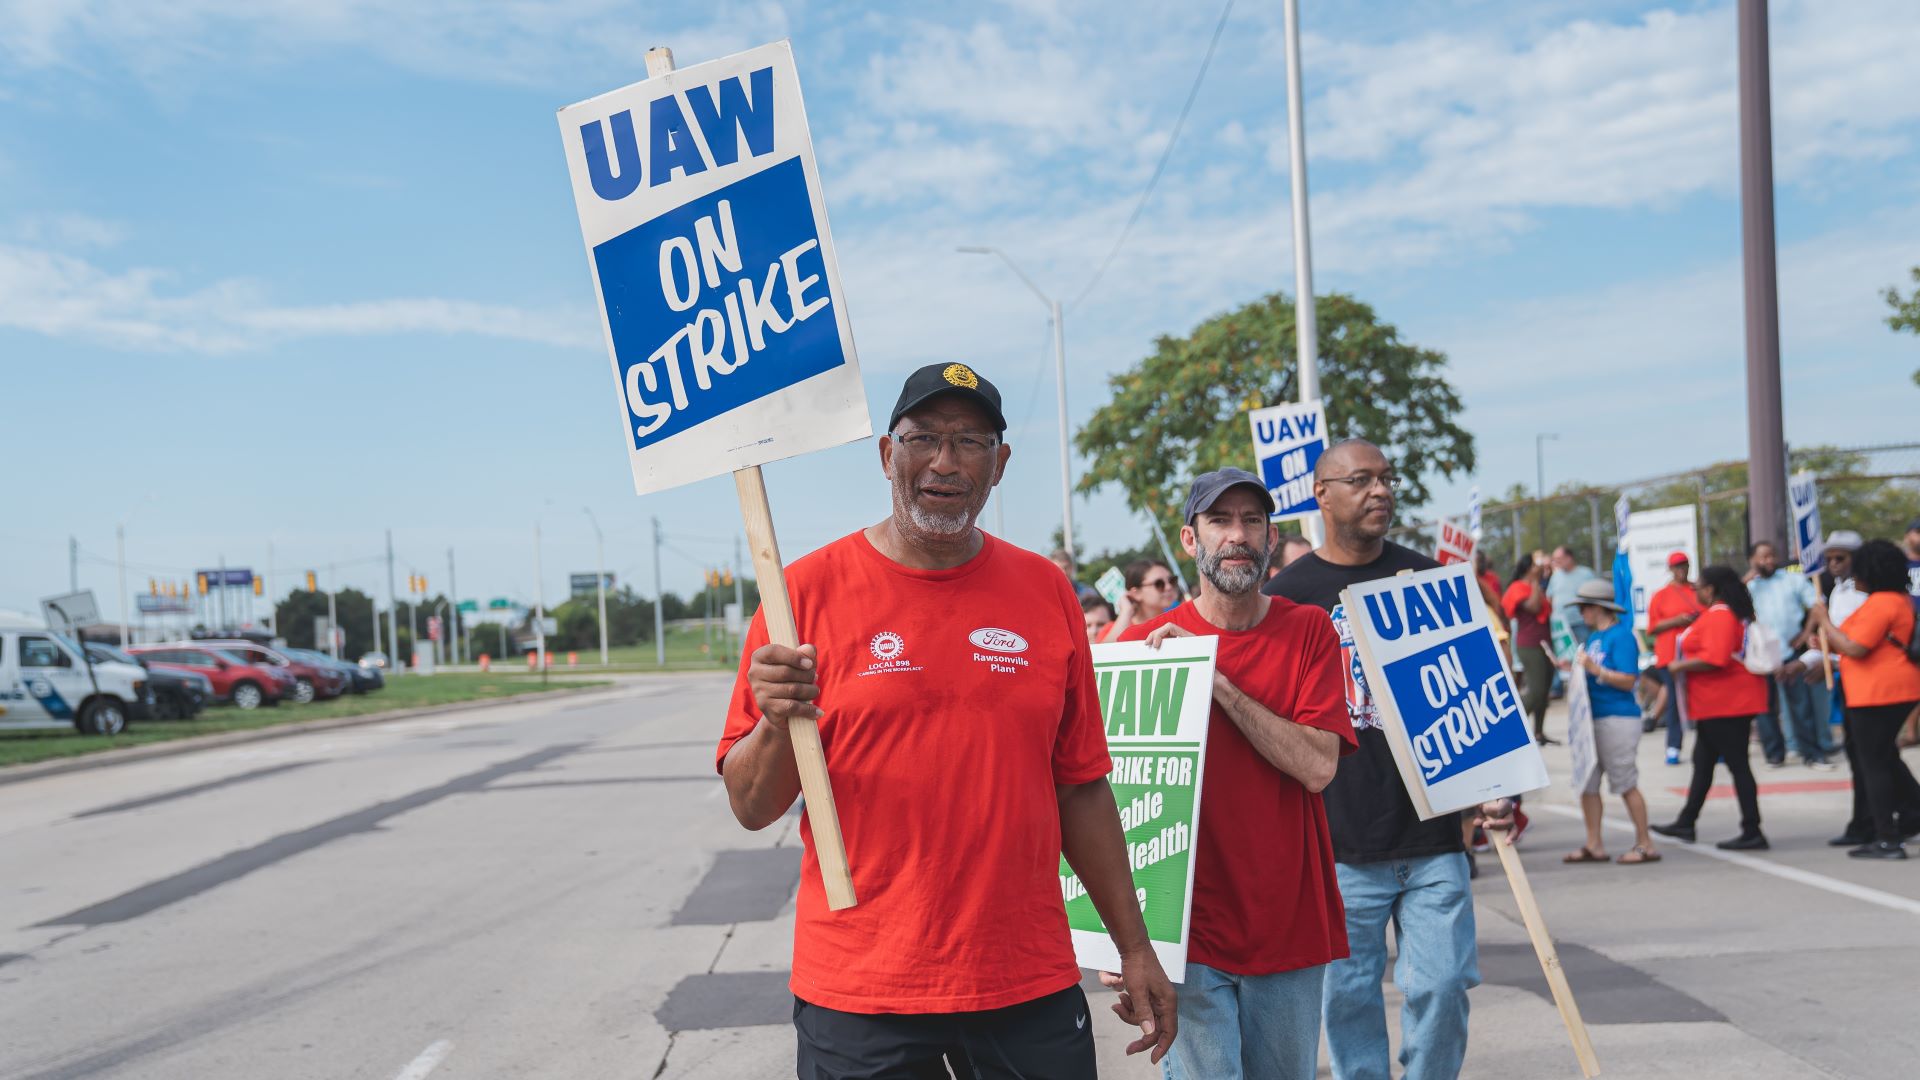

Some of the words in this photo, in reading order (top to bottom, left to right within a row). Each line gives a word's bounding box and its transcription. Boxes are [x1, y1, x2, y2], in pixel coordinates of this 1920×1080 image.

[581, 67, 775, 200] UAW
[659, 200, 742, 312] ON
[626, 239, 830, 437] STRIKE
[1257, 413, 1317, 444] UAW
[1281, 448, 1308, 481] ON
[1443, 523, 1473, 556] UAW
[1363, 575, 1472, 641] UAW
[982, 631, 1016, 648] Ford
[868, 661, 895, 670] LOCAL
[973, 652, 1029, 667] Rawsonville
[990, 663, 1016, 674] Plant
[1420, 646, 1468, 709] ON
[1413, 671, 1517, 780] STRIKE
[1111, 756, 1153, 785] RIKE
[1155, 756, 1193, 786] FOR
[1118, 791, 1163, 832] able
